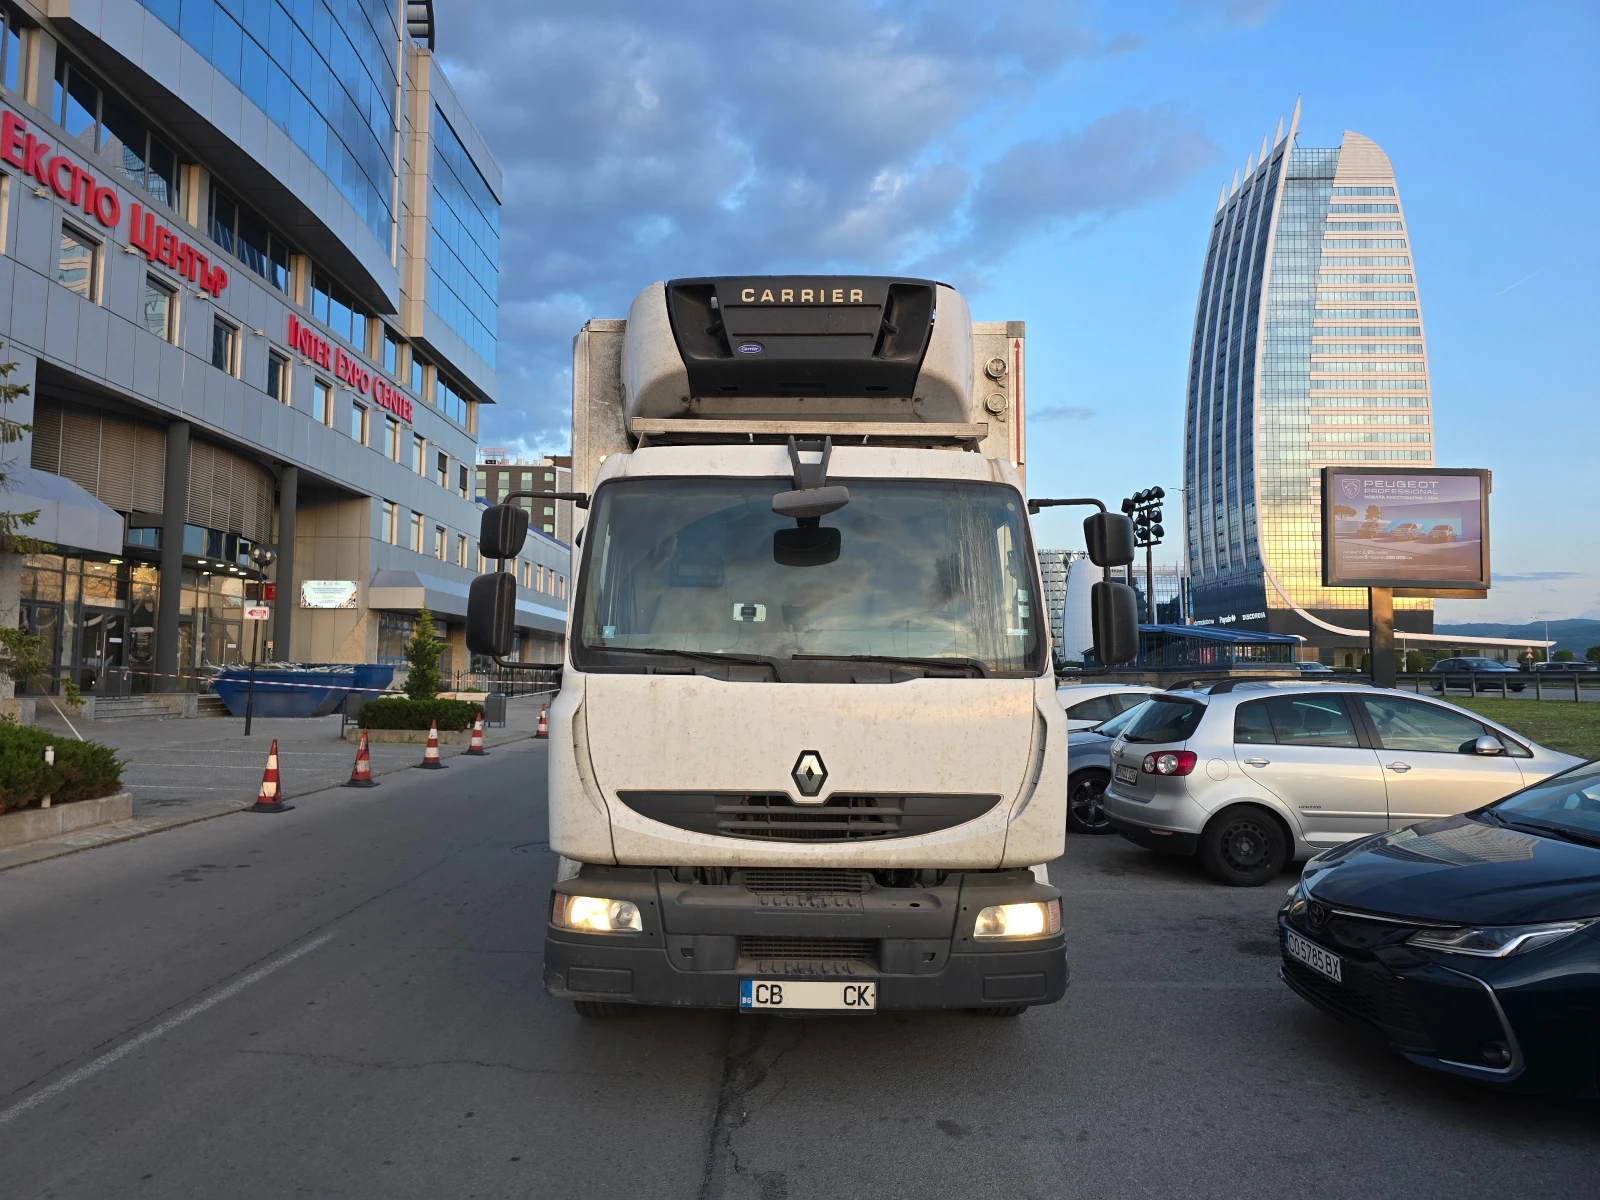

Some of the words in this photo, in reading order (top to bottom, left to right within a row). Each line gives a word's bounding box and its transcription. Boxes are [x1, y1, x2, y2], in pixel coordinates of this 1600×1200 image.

[1, 110, 120, 228] ЕКСПО
[130, 202, 228, 298] ЦЕНТЪР
[741, 288, 863, 303] CARRIER
[287, 313, 332, 371] INTER
[335, 347, 371, 395] EXPO
[372, 376, 413, 424] CENTER
[1364, 480, 1439, 489] PEUGEOT
[1242, 611, 1266, 621] DISCORDIA
[742, 996, 752, 1004] BG
[756, 984, 783, 1005] CB
[843, 985, 870, 1006] CK
